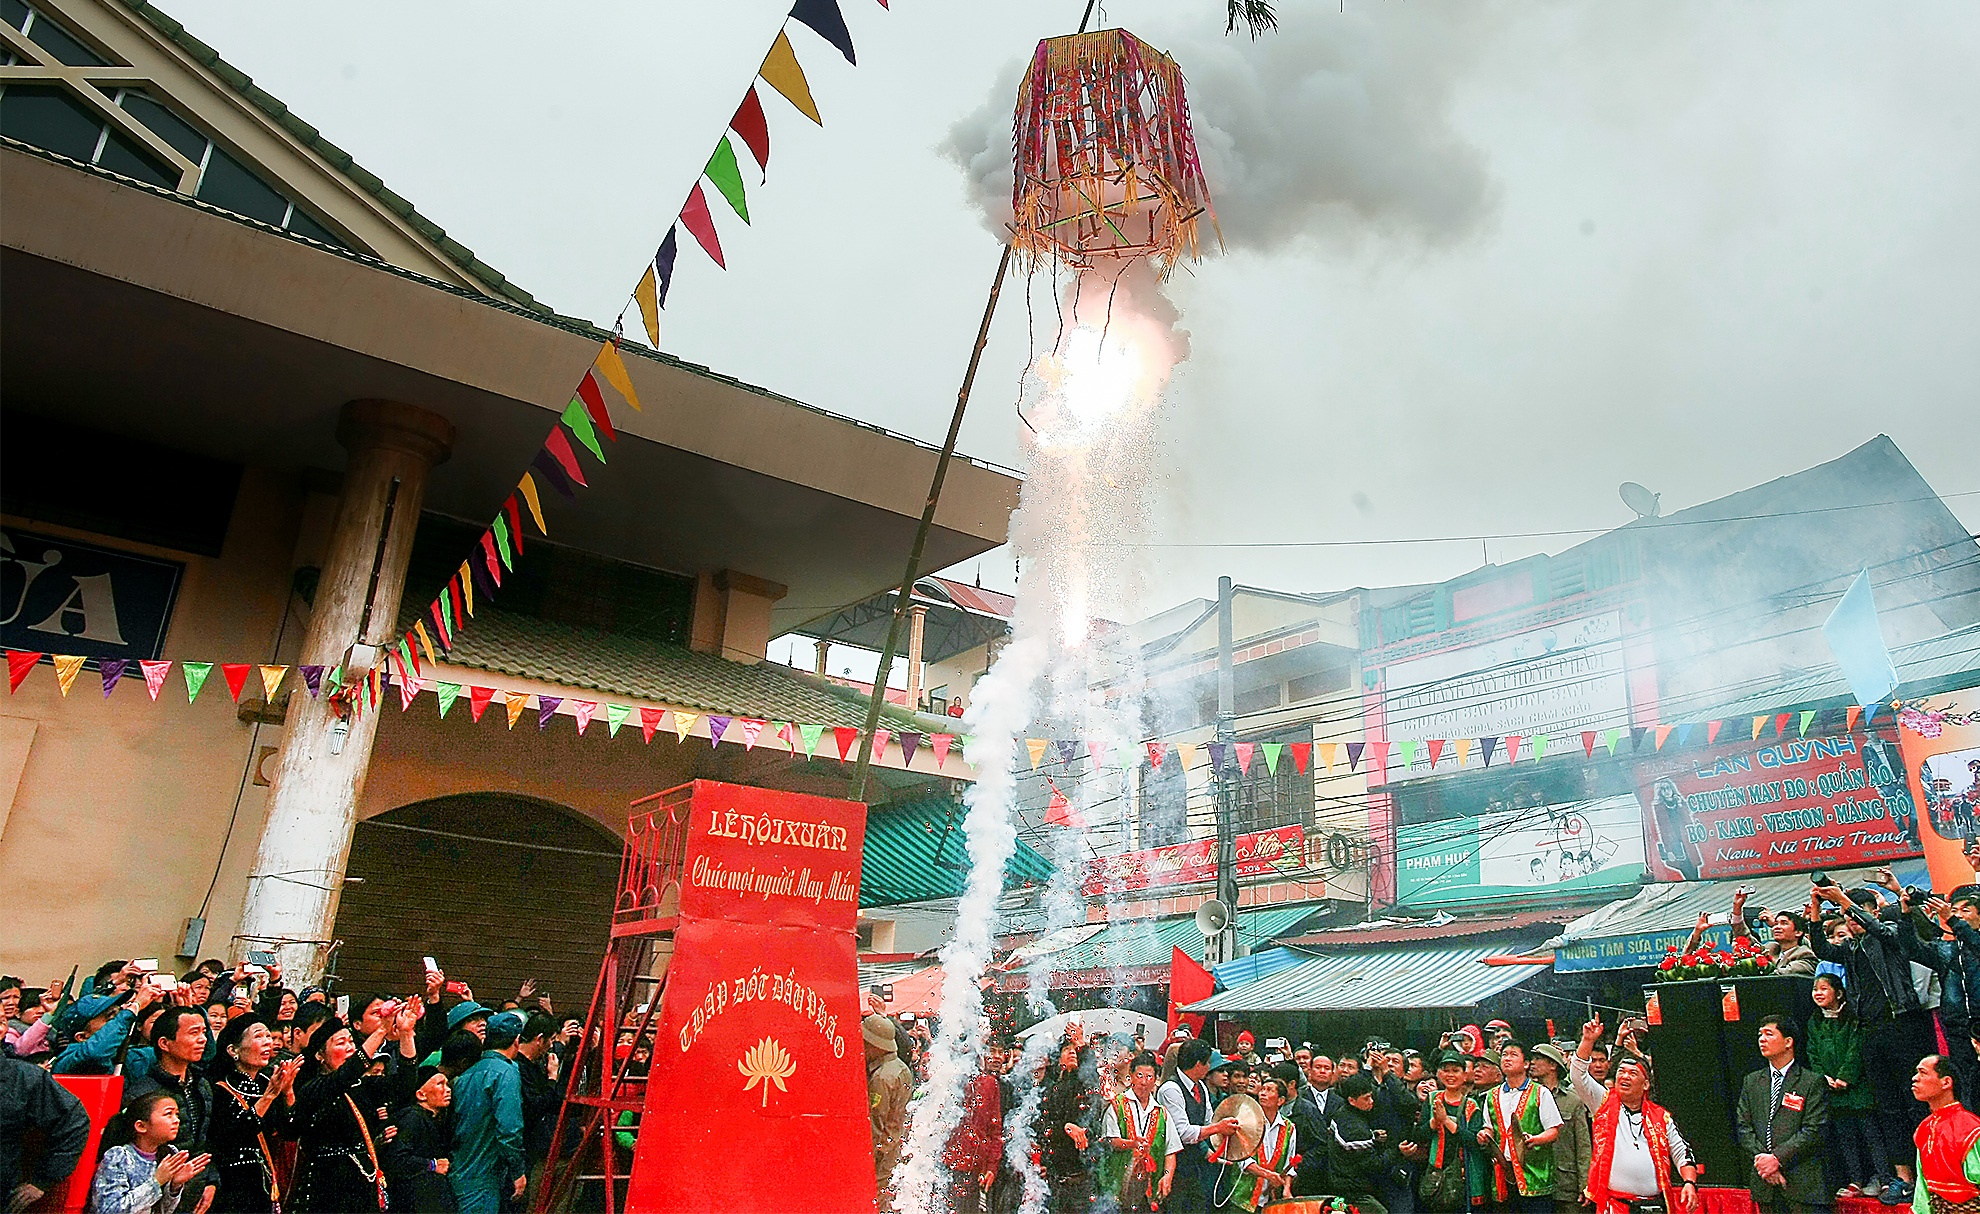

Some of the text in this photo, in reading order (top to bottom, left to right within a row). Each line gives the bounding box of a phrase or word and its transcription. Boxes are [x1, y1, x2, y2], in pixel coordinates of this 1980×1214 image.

[1757, 734, 1857, 768] QUỲNH
[1687, 783, 1747, 813] CHUYÊN
[1746, 781, 1781, 804] MAY
[1782, 777, 1807, 800] ĐO
[1685, 789, 1910, 843] BÒ KAKI VESTON MĂNG TÔ
[784, 819, 847, 851] XUÂN
[1849, 830, 1909, 846] Trang
[1406, 849, 1471, 870] PHẠM HUỆ
[692, 855, 855, 905] Chúc mọi người May Mắn
[1627, 935, 1653, 954] SỬA
